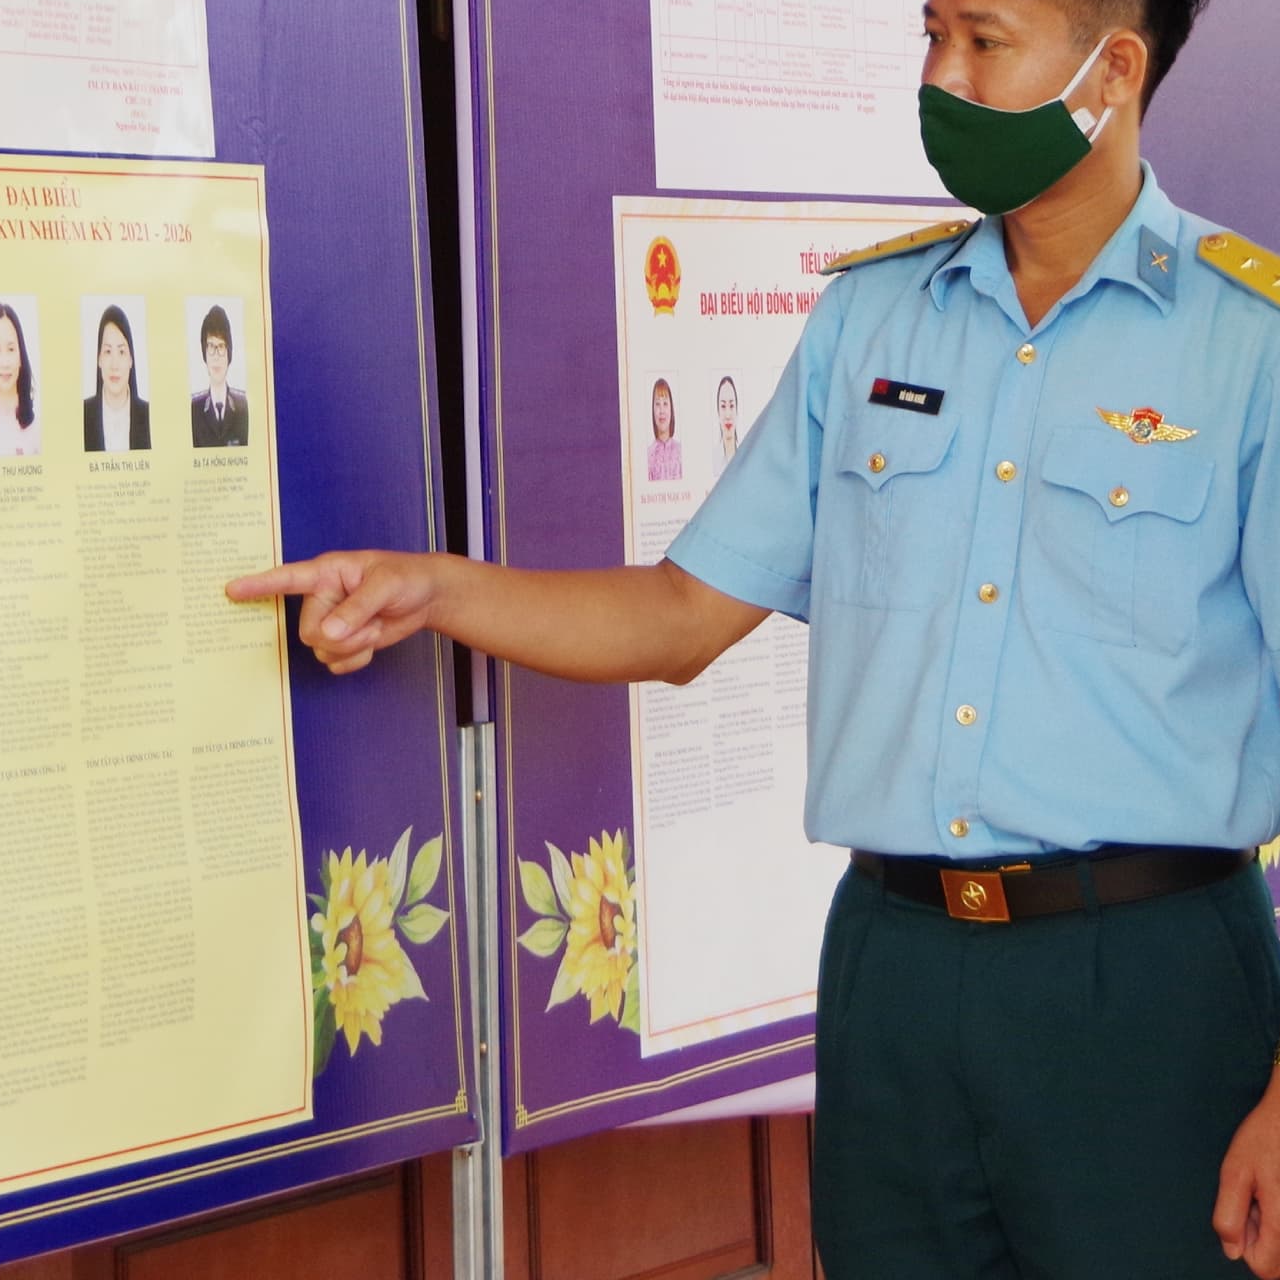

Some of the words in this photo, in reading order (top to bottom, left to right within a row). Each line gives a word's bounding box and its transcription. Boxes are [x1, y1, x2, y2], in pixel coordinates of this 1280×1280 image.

[6, 185, 38, 211] ĐẠI
[42, 177, 82, 209] BIỂU
[28, 214, 86, 243] NHIỆM
[91, 216, 114, 241] KỲ
[119, 222, 150, 242] 2021
[163, 223, 192, 243] 2026
[800, 243, 820, 274] TIỂU
[796, 288, 821, 314] NHÂ
